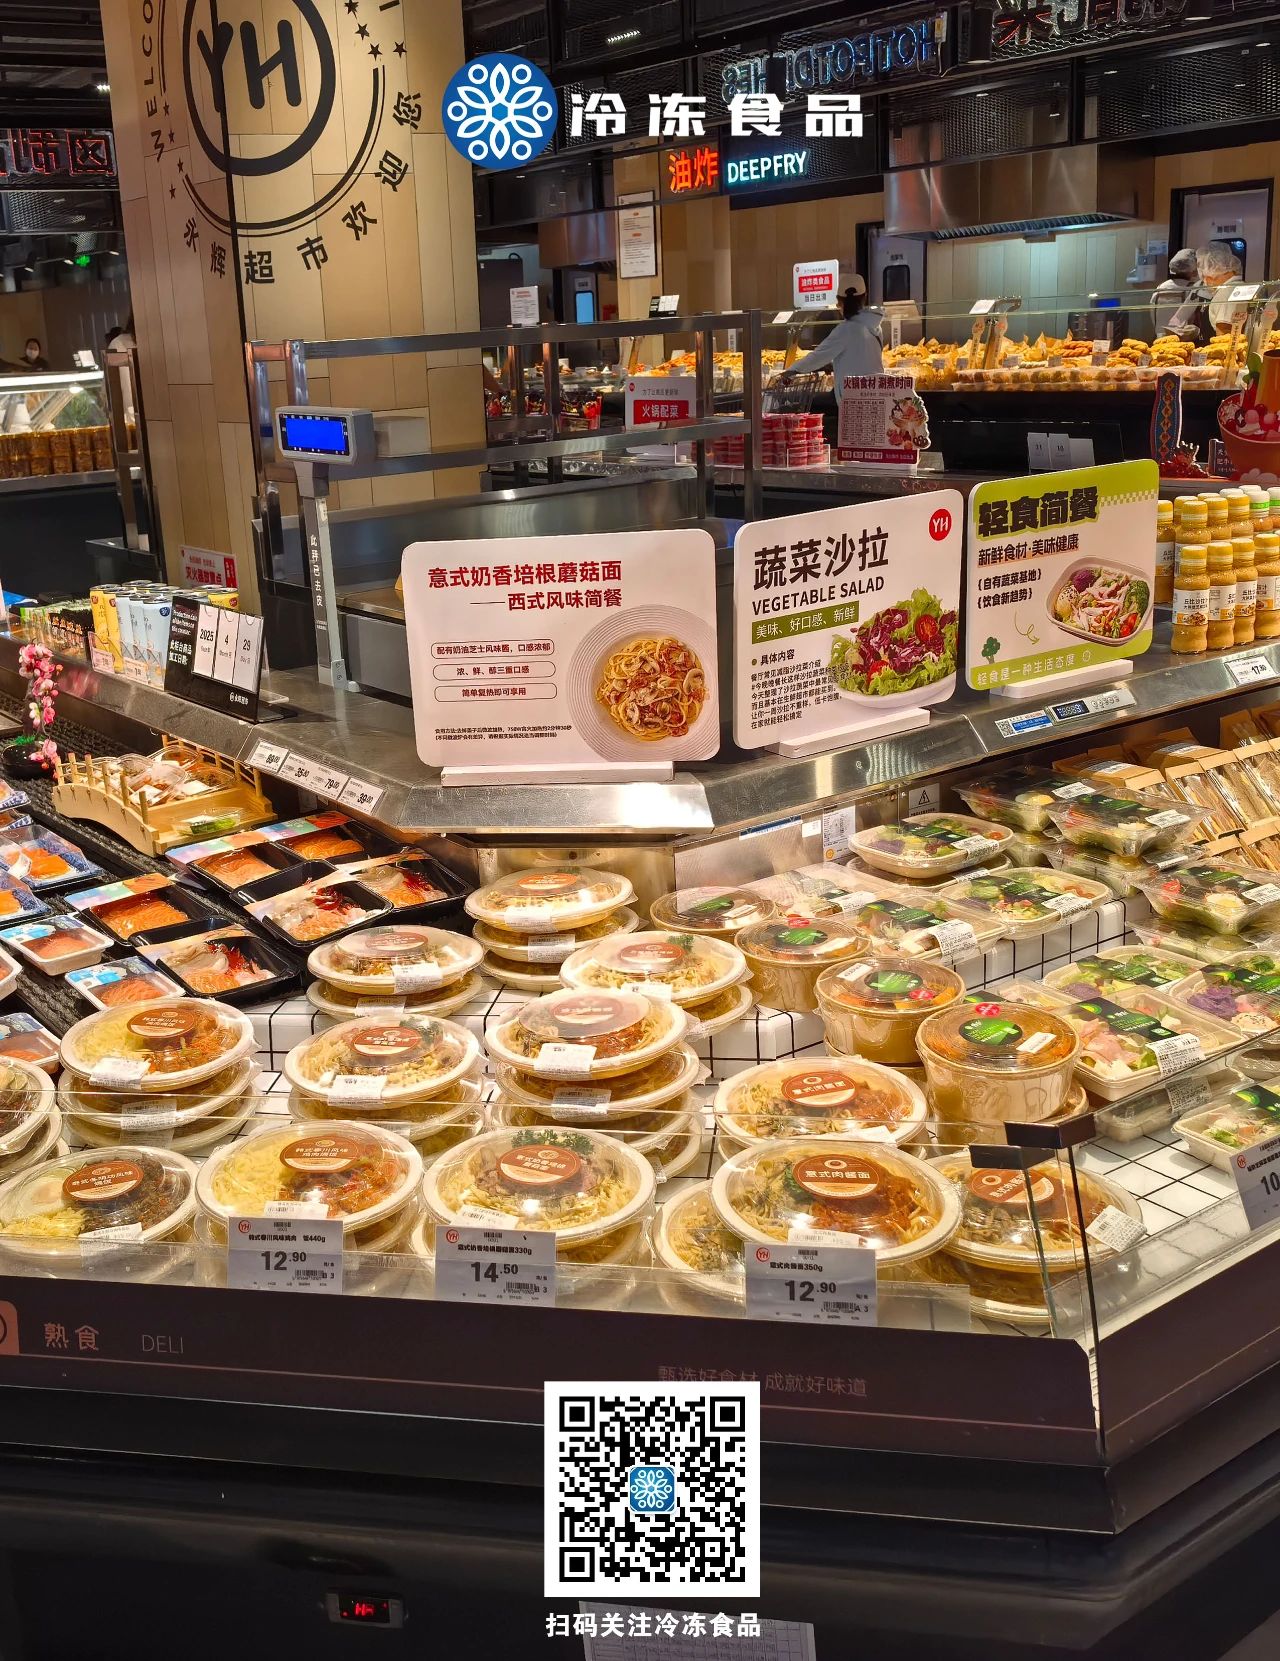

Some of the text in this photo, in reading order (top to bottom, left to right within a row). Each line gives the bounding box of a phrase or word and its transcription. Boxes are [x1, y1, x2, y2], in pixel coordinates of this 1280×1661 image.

[197, 19, 302, 113] YH
[668, 145, 719, 193] 油炸
[726, 150, 808, 185] DEEPFRY
[844, 376, 914, 389] 火锅食材 涮煮时间
[642, 404, 680, 418] 火锅配菜
[978, 485, 1098, 537] 轻食简餐
[753, 526, 889, 591] 蔬菜沙拉
[428, 560, 622, 589] 意式奶香培根蘑菇面
[752, 576, 885, 615] VEGETABLE SALAD
[756, 605, 855, 639] 美味、好口感、新鲜
[200, 629, 214, 642] 2025
[224, 634, 229, 646] 4
[760, 648, 795, 666] 具体内容
[977, 653, 1075, 685] 轻食是一种生活态度
[461, 687, 526, 698] 简单复热即可享用
[791, 1080, 846, 1095] 意式肉酱面
[805, 1170, 870, 1179] 意式肉酱面
[261, 1250, 307, 1272] 12.90
[470, 1261, 519, 1284] 14.50
[784, 1280, 837, 1302] 12.90
[44, 1322, 100, 1351] 熟食
[141, 1334, 184, 1354] DELI
[765, 1370, 868, 1398] 成就好味道
